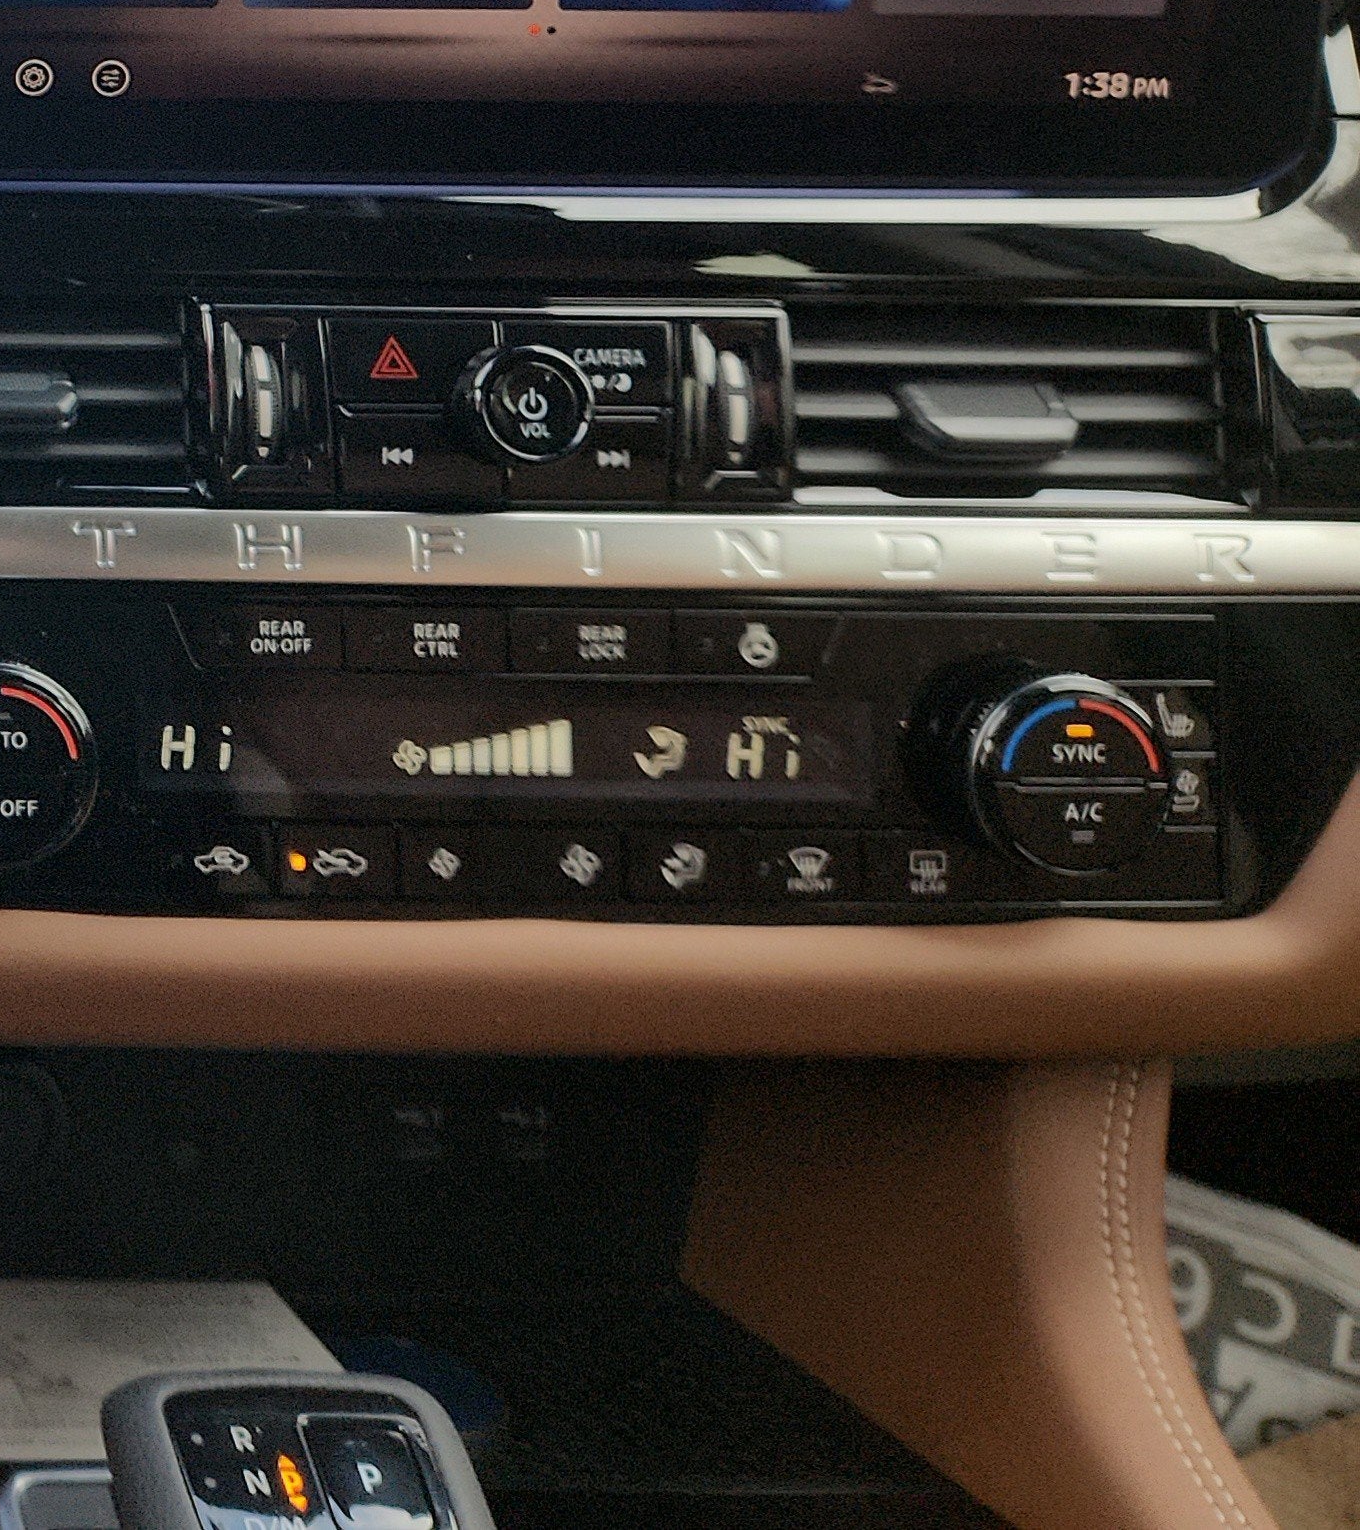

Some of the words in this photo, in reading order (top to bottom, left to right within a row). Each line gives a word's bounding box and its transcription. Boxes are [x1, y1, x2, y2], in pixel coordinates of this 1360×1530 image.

[573, 347, 646, 368] CAMERA
[519, 422, 551, 439] VOL
[259, 621, 305, 637] REAR
[413, 623, 460, 640] REAR
[413, 641, 459, 658] CTRL
[1052, 743, 1106, 764] SYNC
[1065, 802, 1103, 823] A/C
[230, 1425, 255, 1453] R
[243, 1468, 271, 1496] N
[356, 1462, 382, 1494] P
